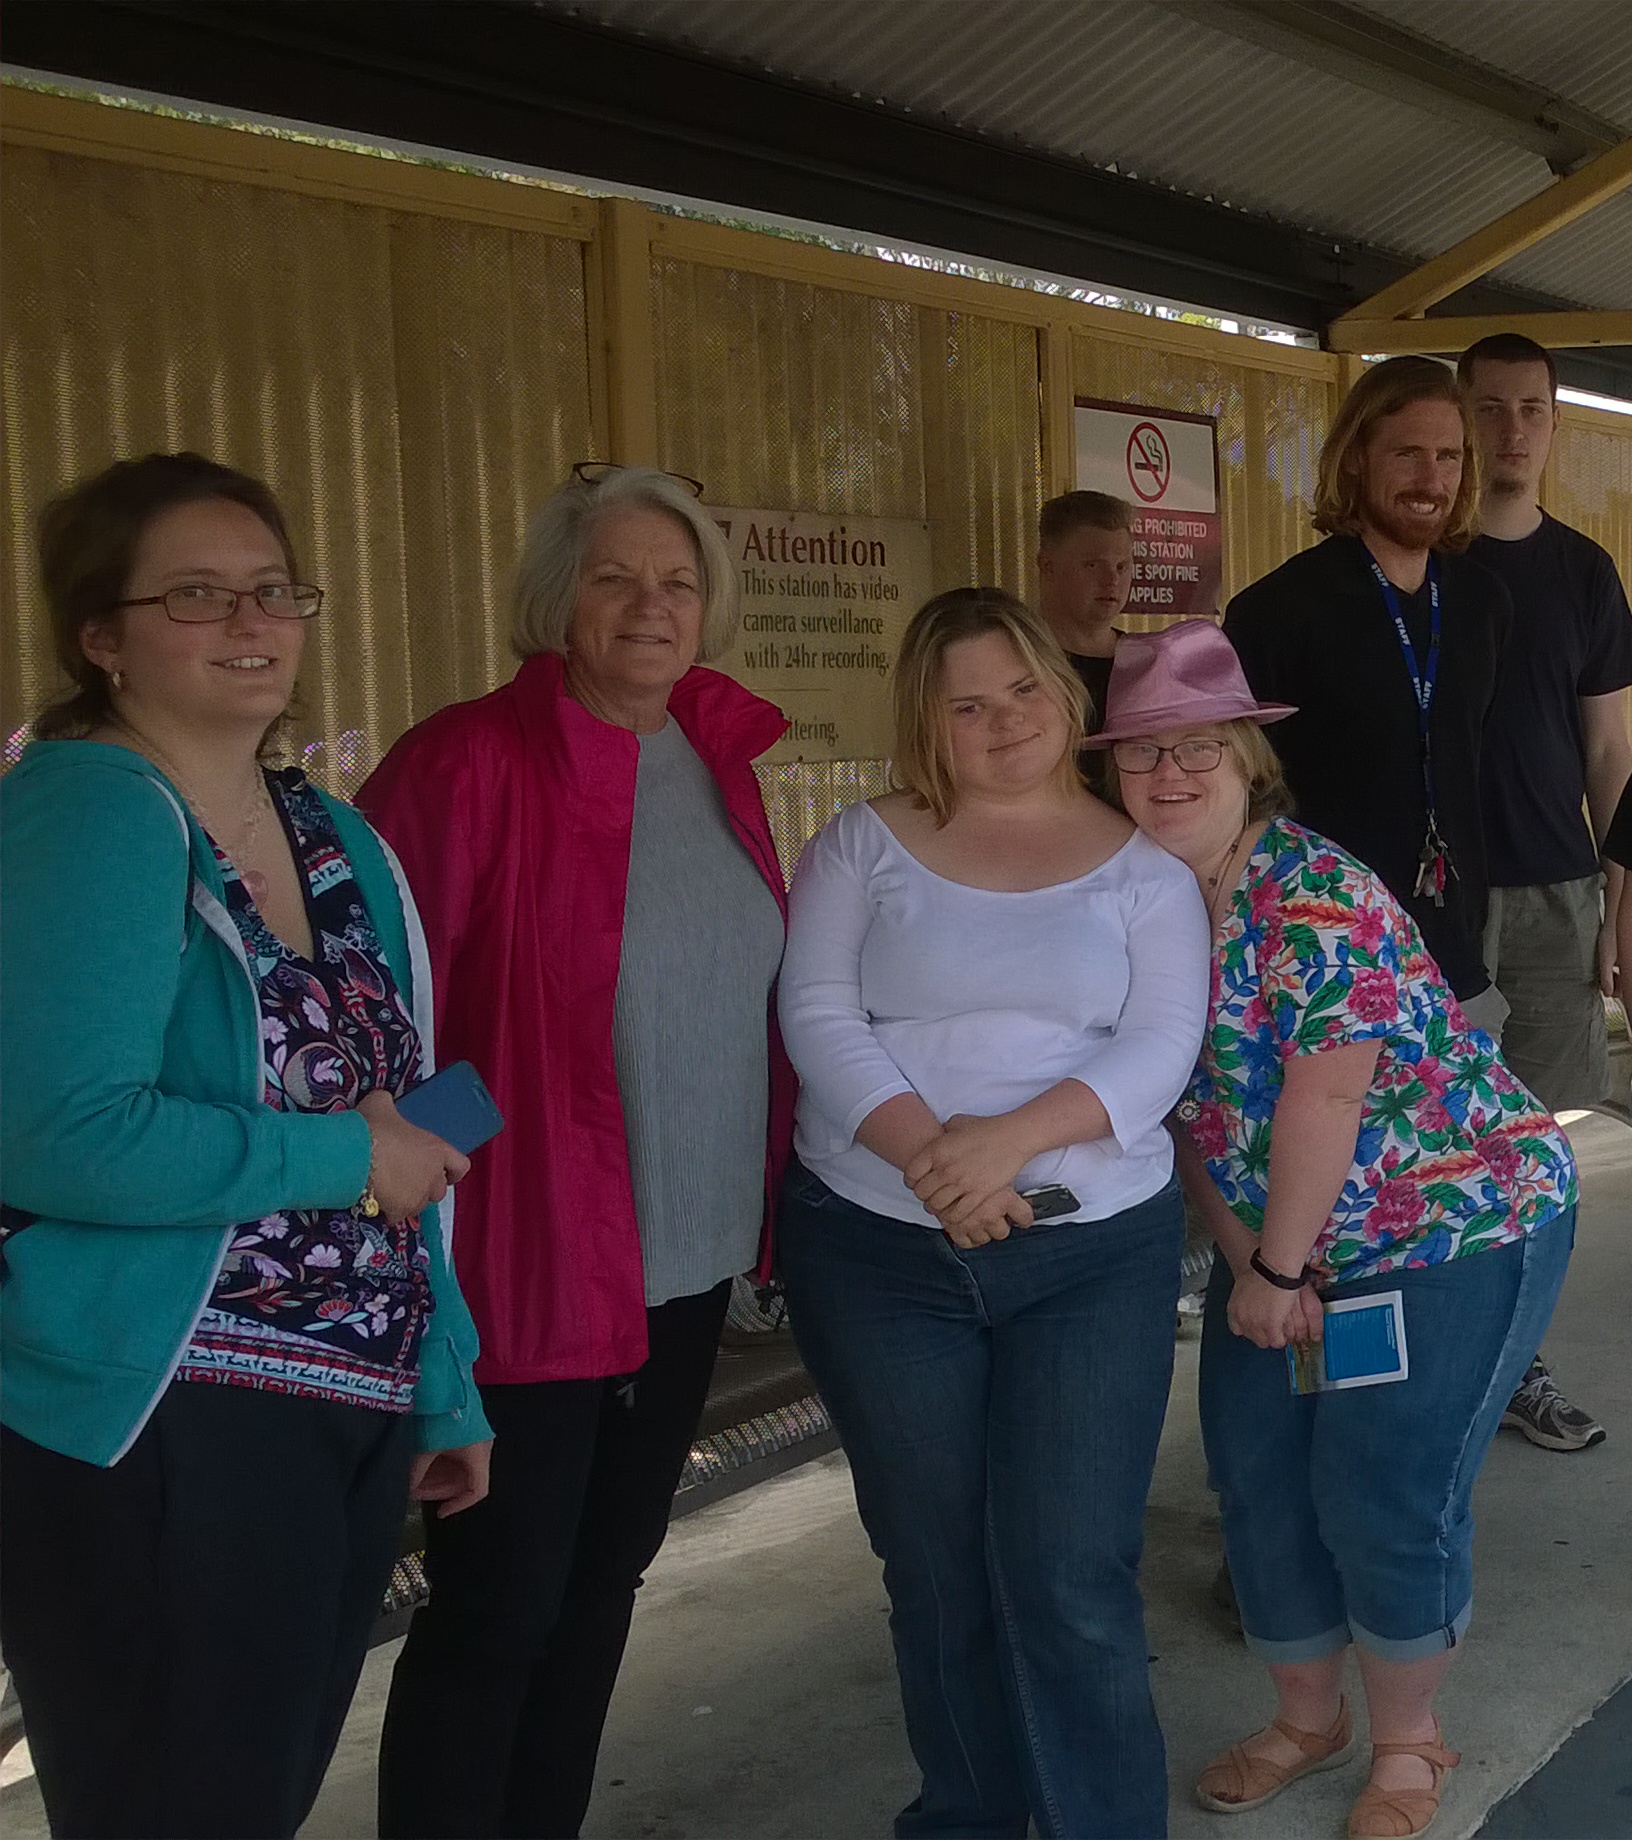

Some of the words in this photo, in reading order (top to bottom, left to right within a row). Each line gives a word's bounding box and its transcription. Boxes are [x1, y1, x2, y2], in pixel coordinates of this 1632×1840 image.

[1145, 518, 1207, 538] PROHIBITED
[742, 523, 886, 567] Attention
[1150, 541, 1194, 559] STATION
[741, 568, 775, 596] This
[779, 571, 829, 598] station
[833, 572, 857, 600] has
[861, 574, 899, 601] video
[1145, 564, 1174, 581] SPOT
[1176, 566, 1199, 582] FINE
[1370, 562, 1390, 588] STAFF
[1129, 586, 1174, 604] APPLIES
[743, 611, 796, 634] camera
[801, 608, 884, 635] surveillance
[1394, 616, 1412, 646] STAFF
[744, 642, 779, 670] with
[785, 642, 818, 670] 24hr
[822, 643, 890, 677] recording.
